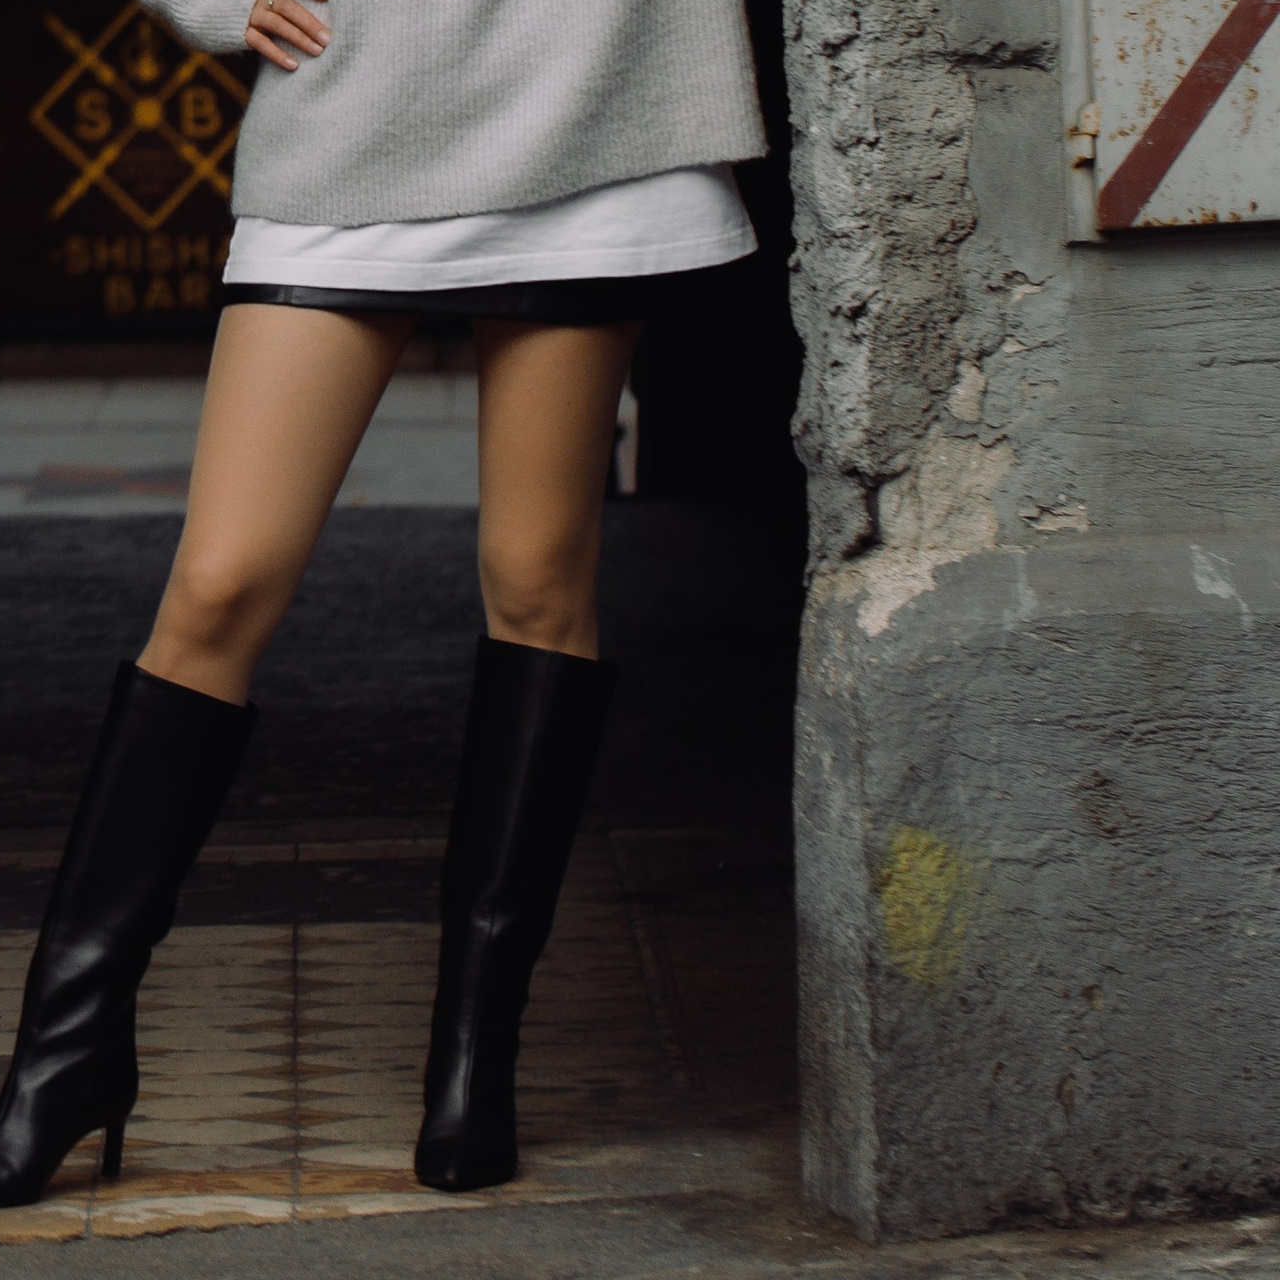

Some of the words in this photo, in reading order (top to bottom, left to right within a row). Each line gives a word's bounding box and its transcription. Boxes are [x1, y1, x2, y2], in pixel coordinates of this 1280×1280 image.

[74, 87, 113, 141] S
[180, 85, 222, 139] B
[103, 273, 211, 318] BAR
